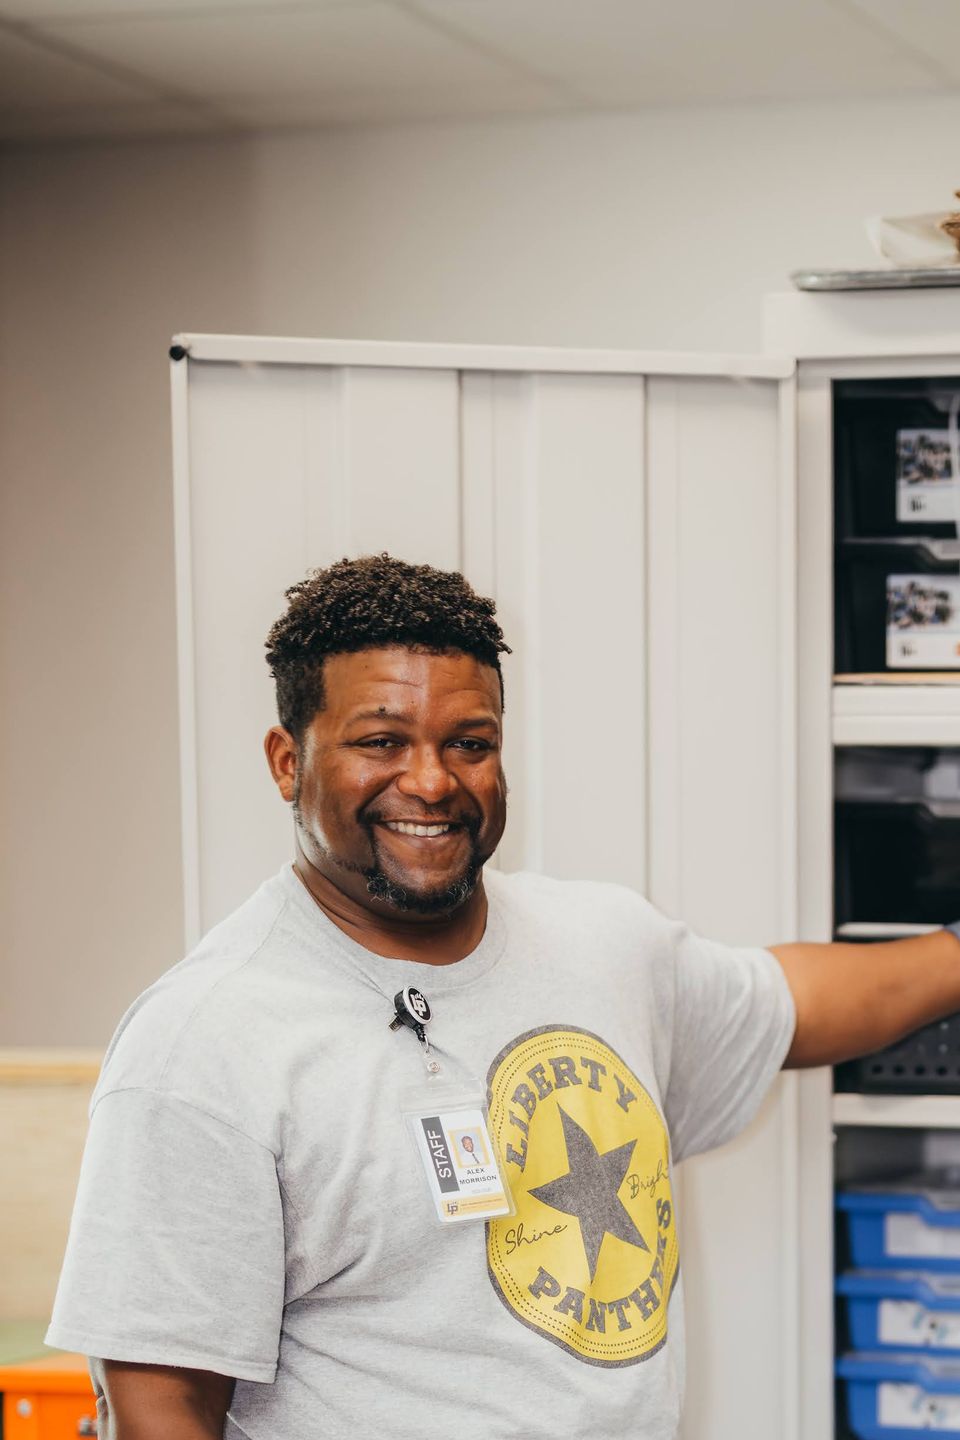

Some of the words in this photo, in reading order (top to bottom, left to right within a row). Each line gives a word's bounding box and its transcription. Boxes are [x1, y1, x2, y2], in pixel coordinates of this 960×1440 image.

[506, 1056, 638, 1173] LIBERTY
[427, 1129, 452, 1178] STAFF
[466, 1167, 486, 1175] ALEX
[459, 1175, 497, 1185] MORRISON
[626, 1159, 668, 1199] Brigh
[505, 1223, 567, 1255] Shine
